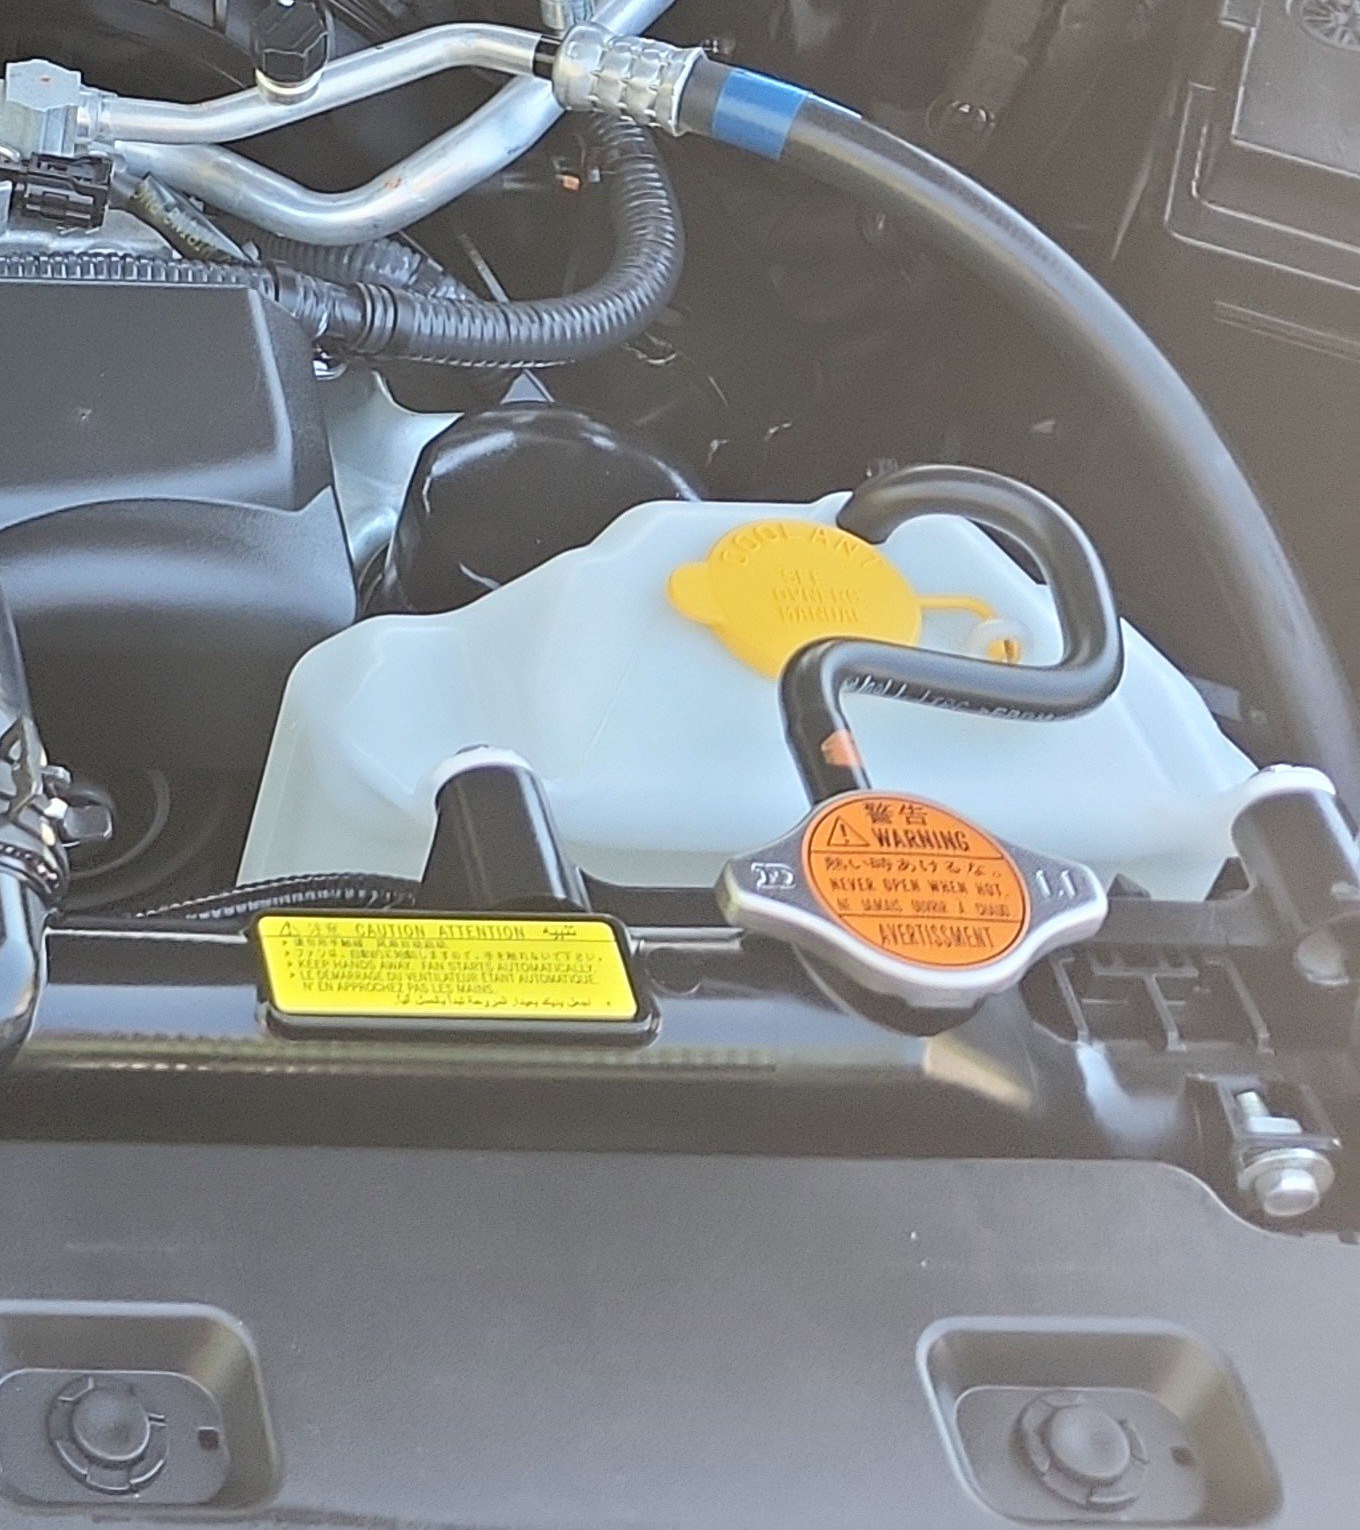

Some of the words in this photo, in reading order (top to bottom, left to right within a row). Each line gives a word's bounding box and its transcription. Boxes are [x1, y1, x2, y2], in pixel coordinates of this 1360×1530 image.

[863, 801, 928, 826] 警告
[871, 827, 970, 852] WARNING
[829, 877, 874, 892] NEVER
[883, 878, 920, 893] OPEN
[928, 879, 968, 895] WHEN
[355, 923, 425, 938] CAUTION
[439, 924, 525, 940] ATTENTION
[298, 959, 330, 970] KEEP
[333, 959, 376, 971] HANDS
